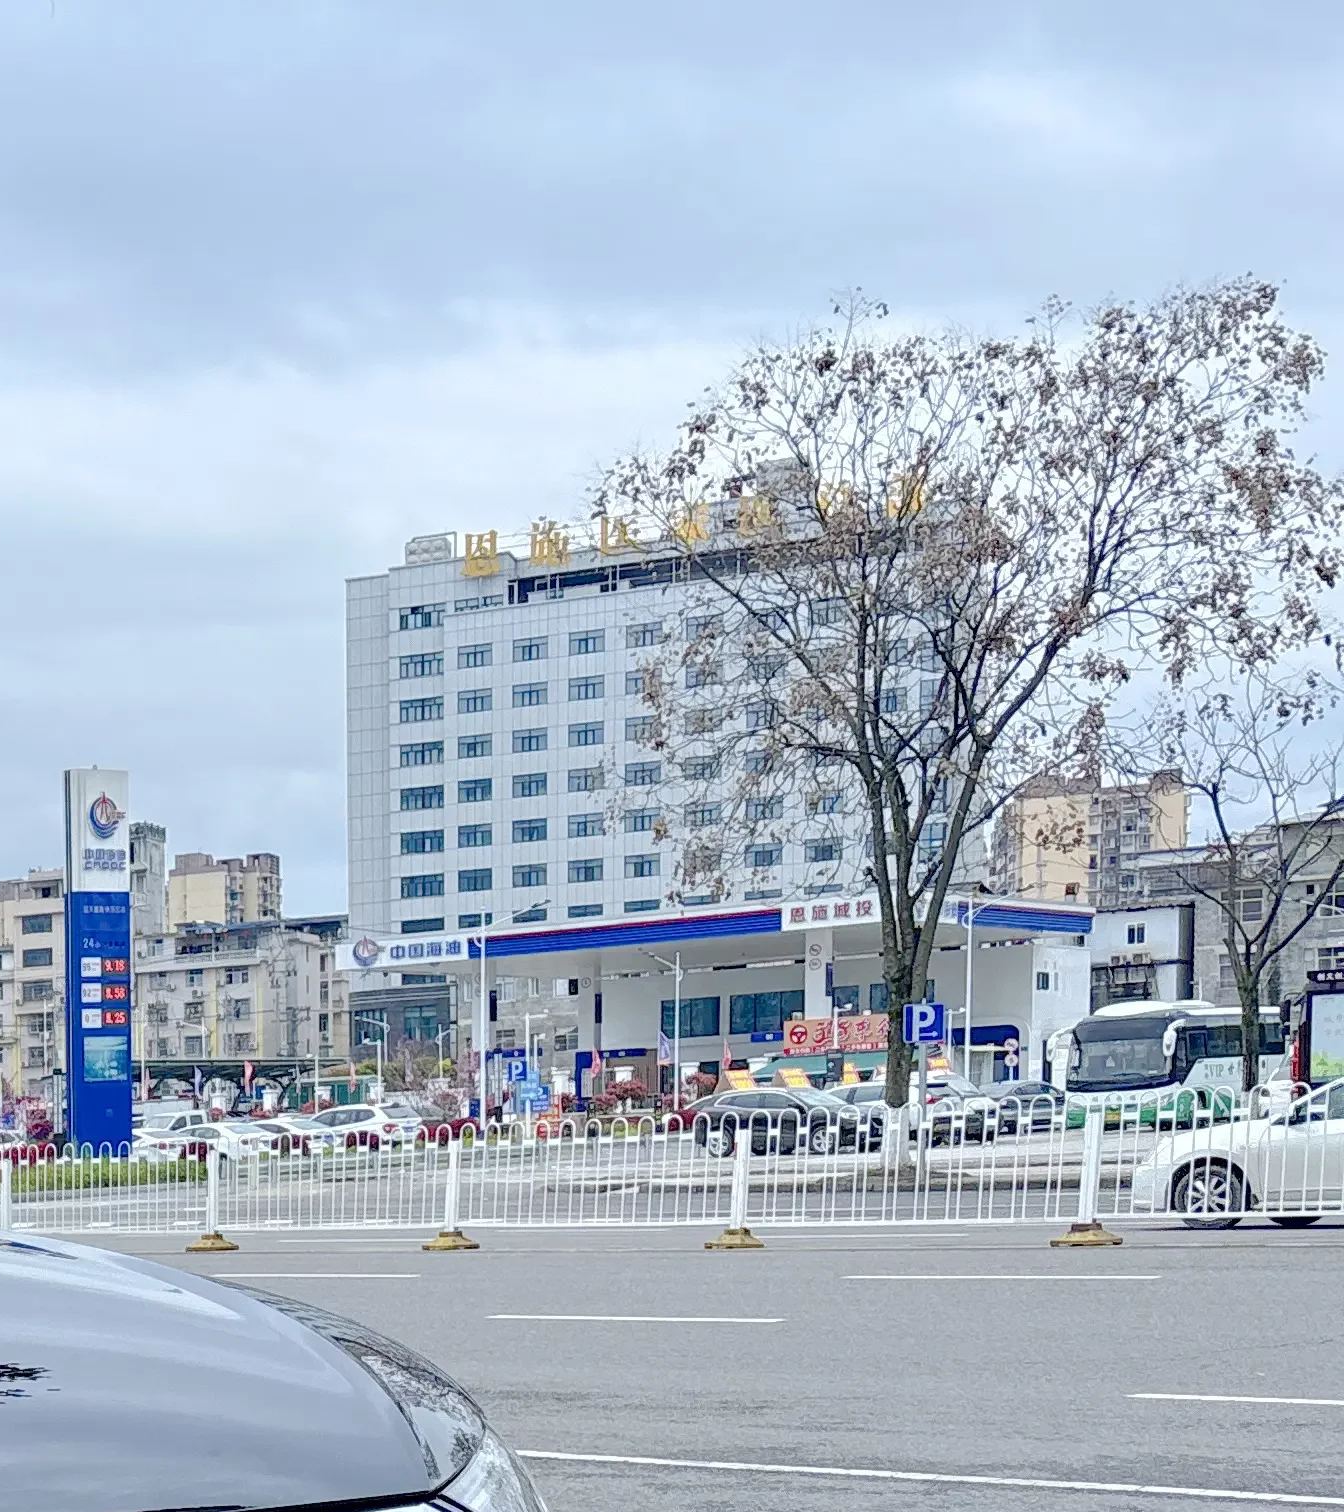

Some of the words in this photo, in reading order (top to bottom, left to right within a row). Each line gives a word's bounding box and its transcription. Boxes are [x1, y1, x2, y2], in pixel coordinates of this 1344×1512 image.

[390, 940, 461, 960] 中国海油
[913, 1006, 936, 1039] P
